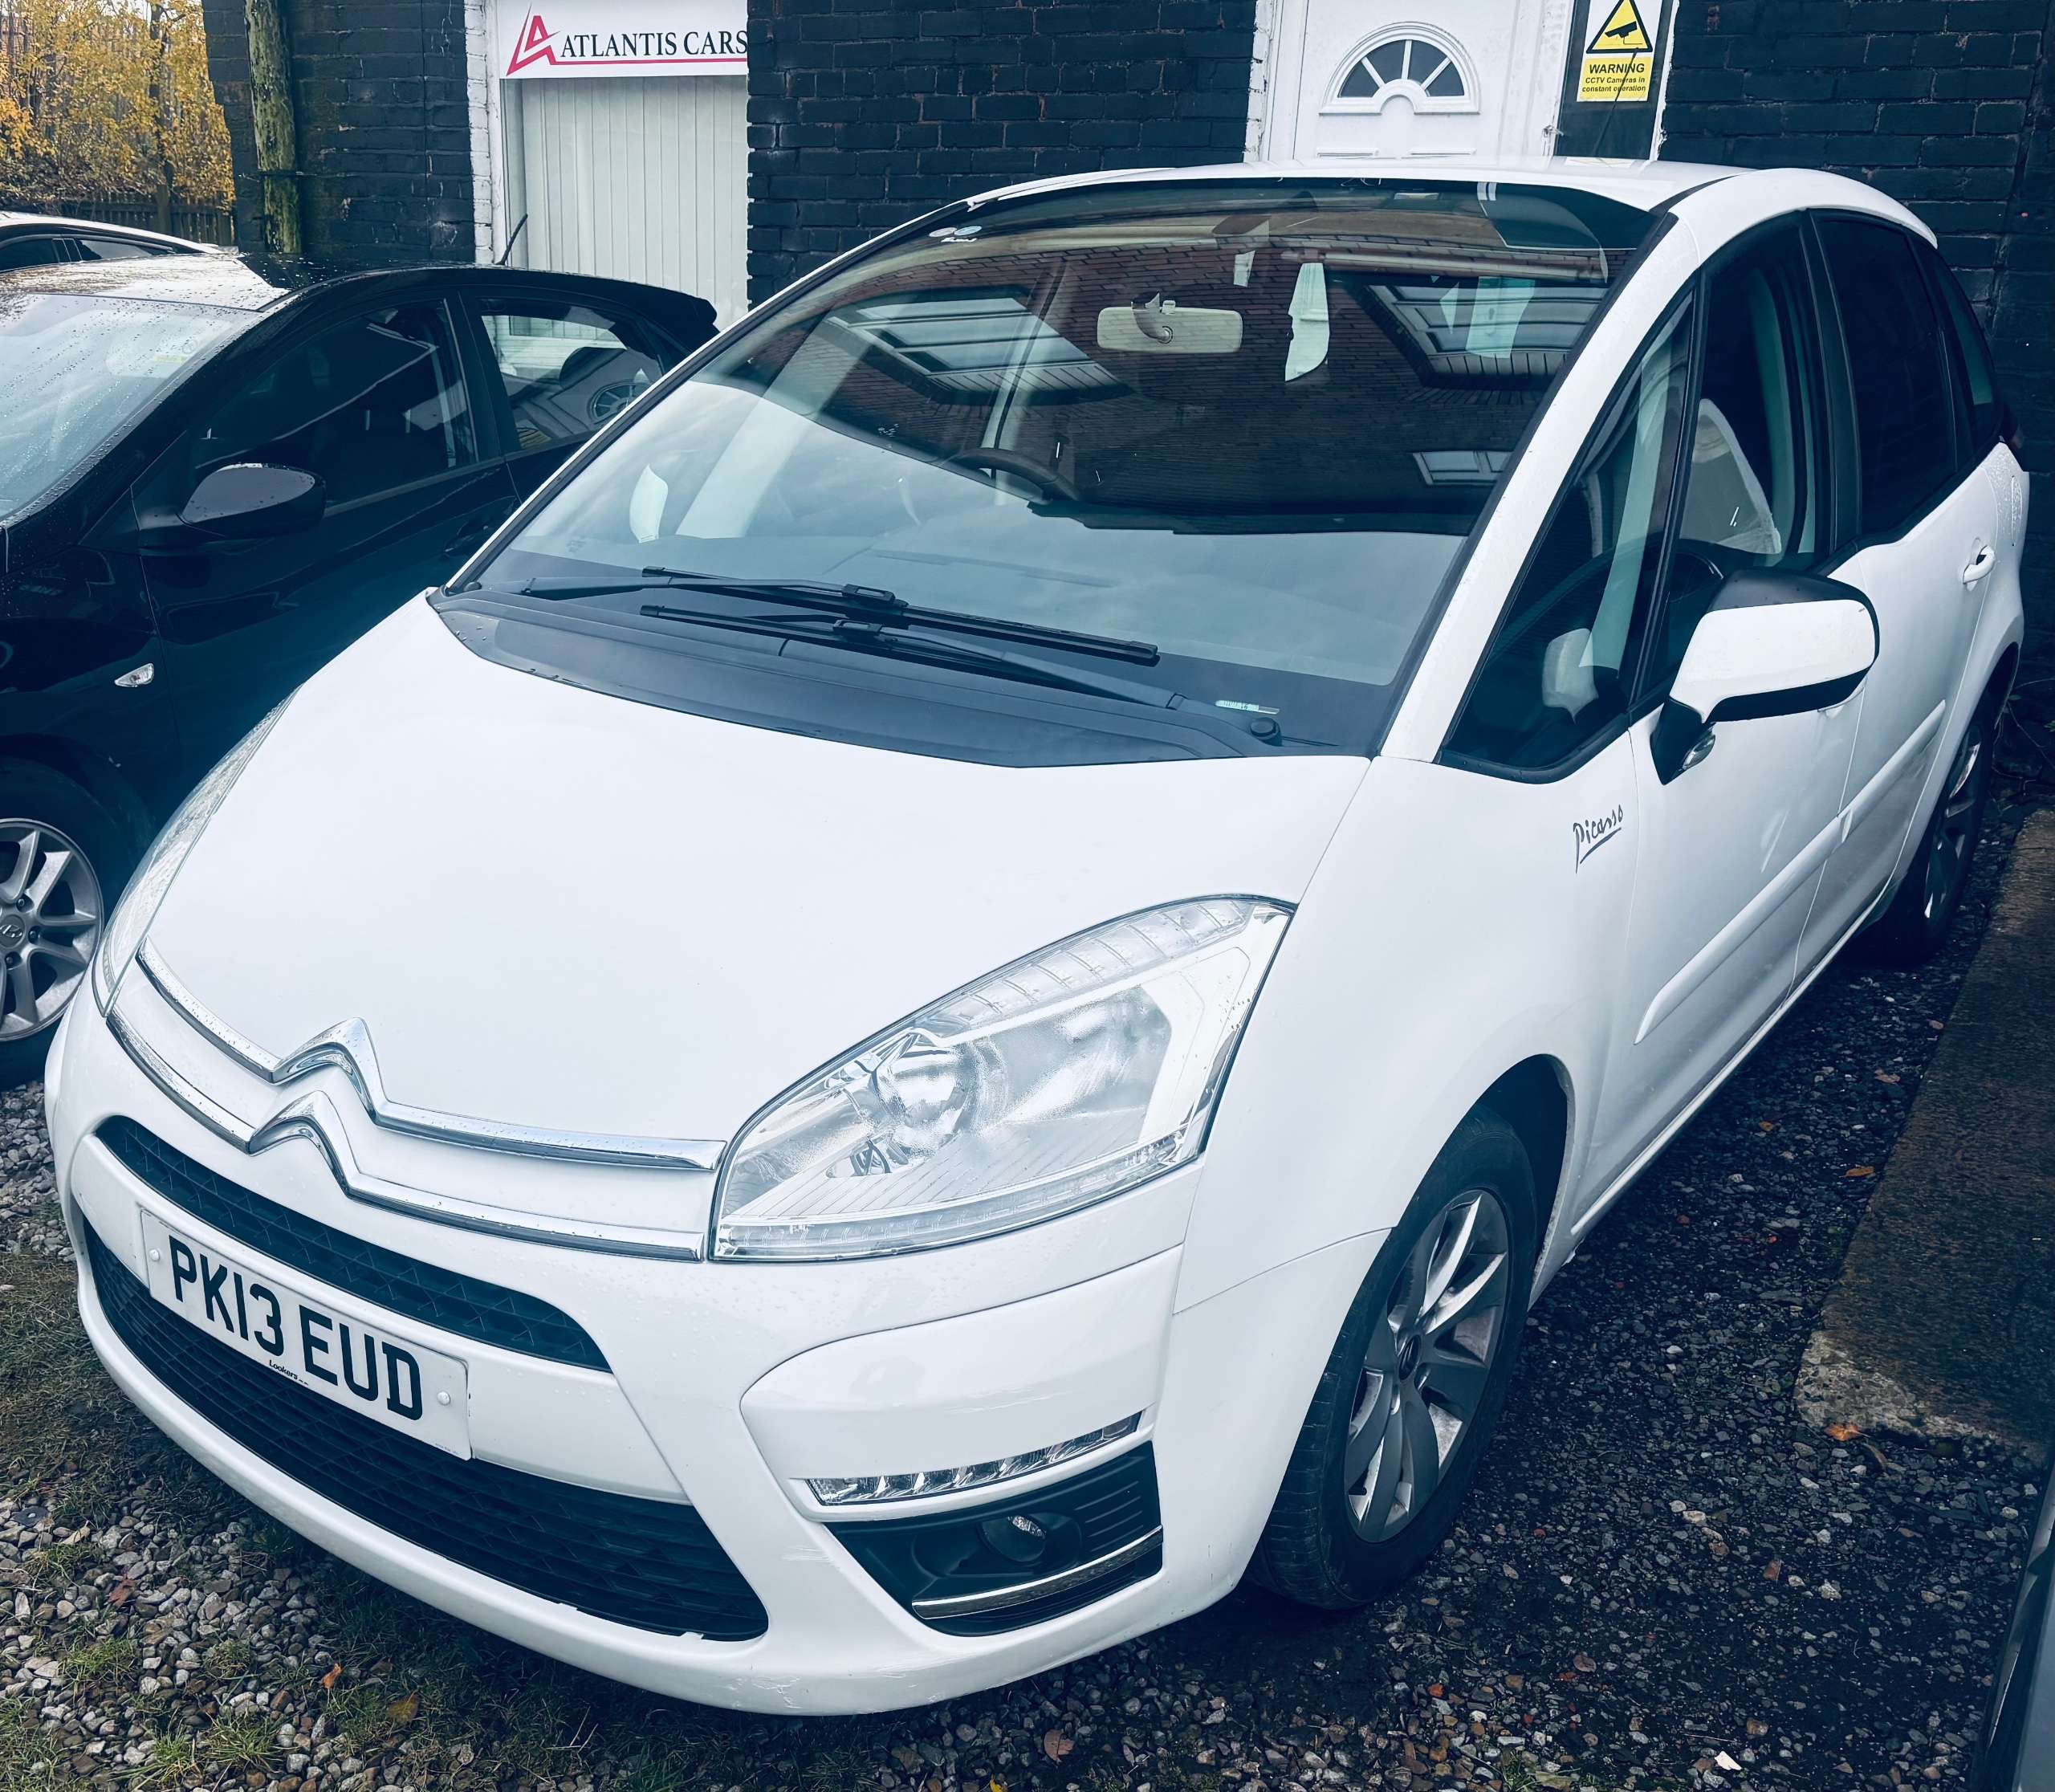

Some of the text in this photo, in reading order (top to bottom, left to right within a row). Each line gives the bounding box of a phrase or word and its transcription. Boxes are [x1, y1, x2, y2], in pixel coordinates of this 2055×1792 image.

[561, 30, 748, 58] ATLANTIS CARS
[1589, 63, 1645, 74] WARNING
[1573, 804, 1623, 874] Picasso
[169, 1234, 423, 1421] PK13 EUD
[269, 1359, 298, 1380] Lookers
